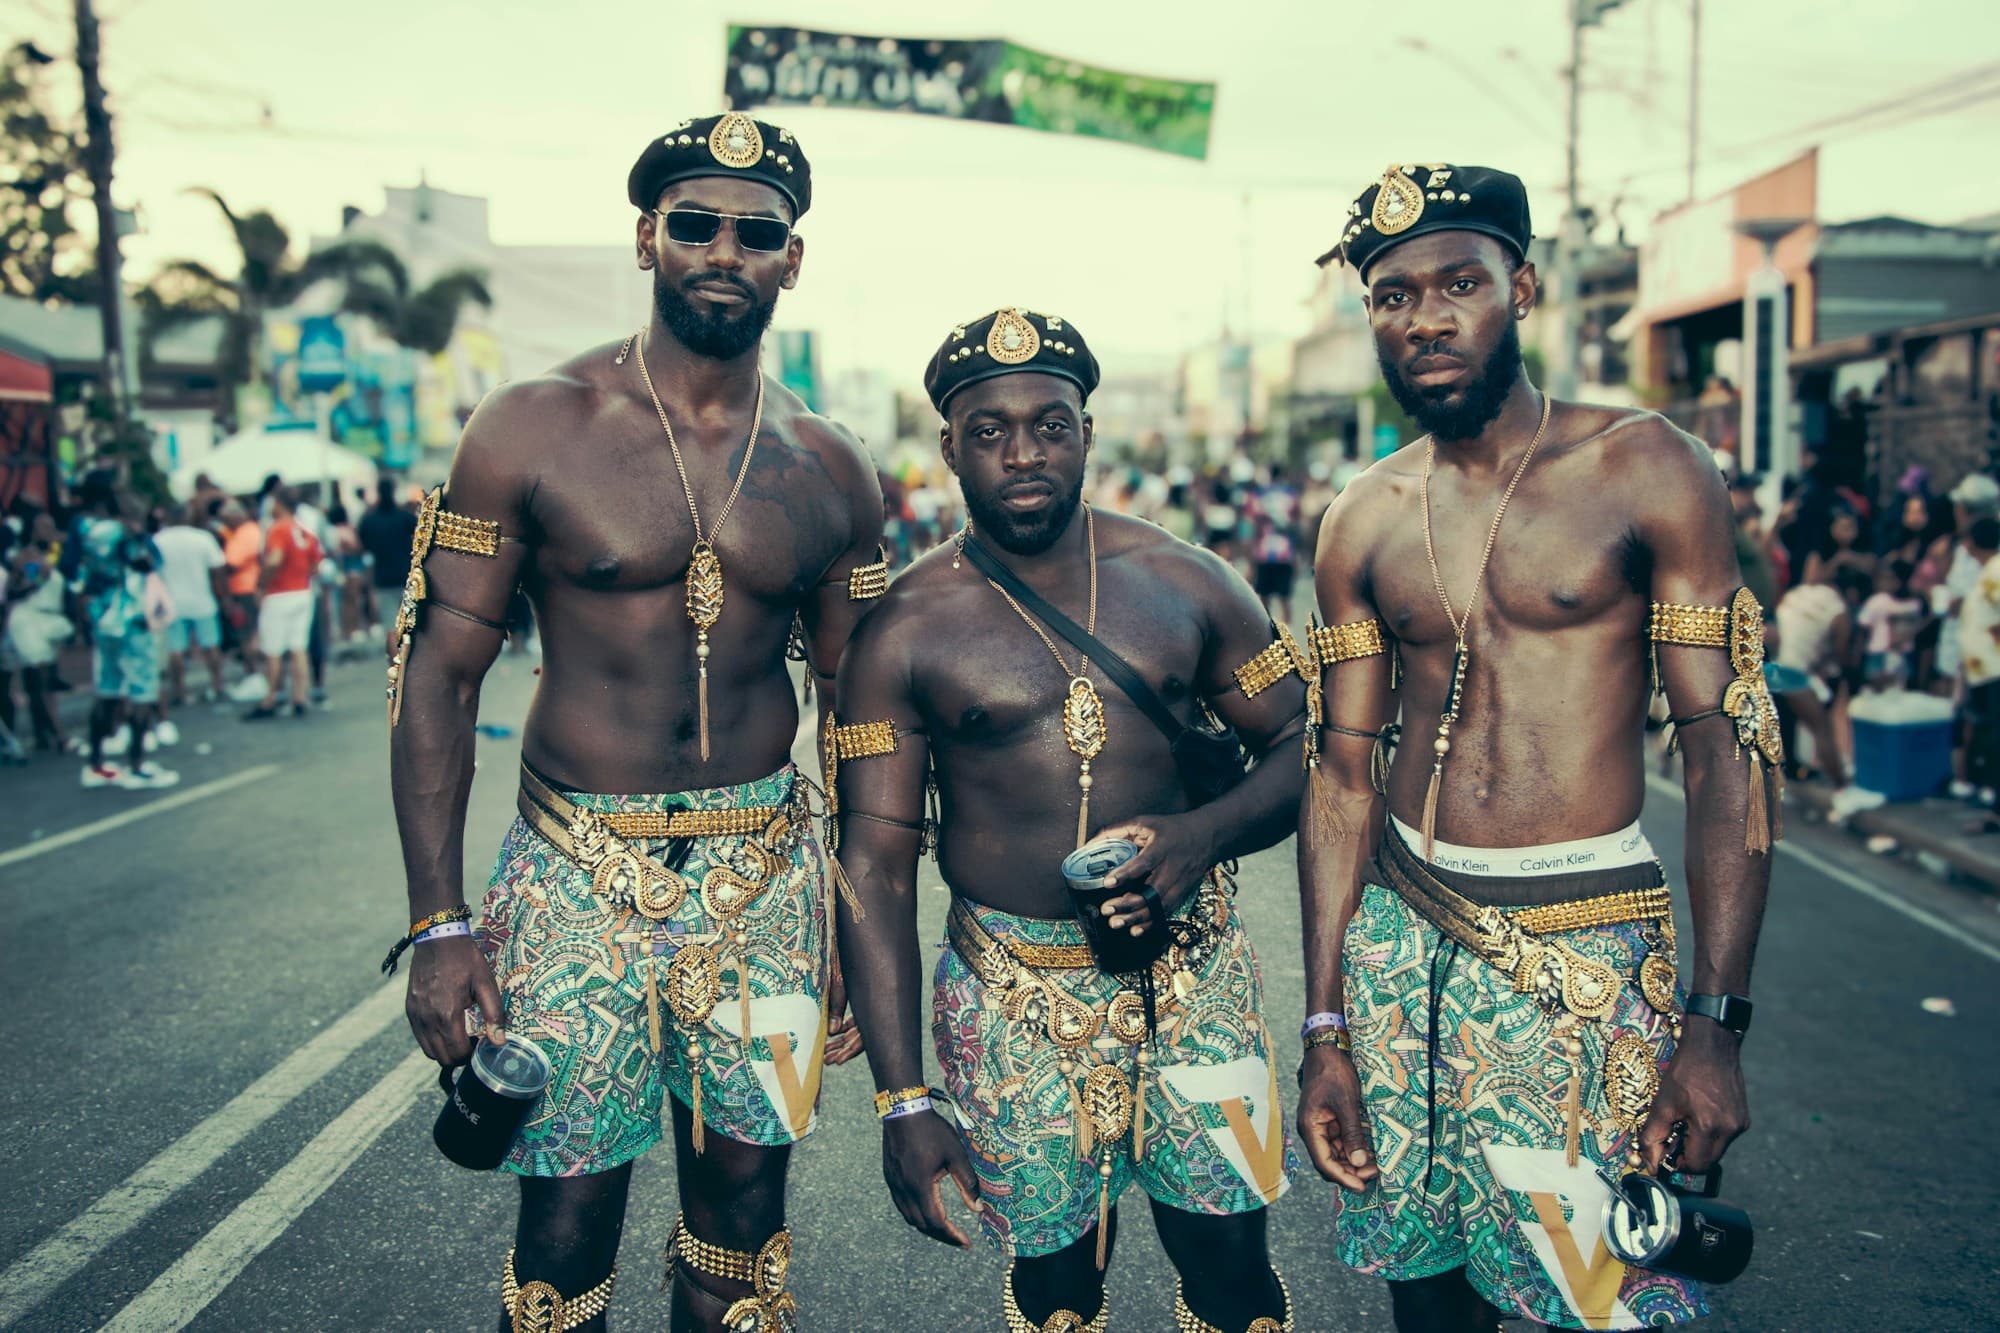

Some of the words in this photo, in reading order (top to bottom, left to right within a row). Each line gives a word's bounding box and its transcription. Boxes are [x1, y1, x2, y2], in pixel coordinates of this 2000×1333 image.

[1434, 855, 1459, 869] alvin
[1461, 859, 1489, 872] Klein
[1519, 856, 1563, 871] Calvin
[1566, 851, 1596, 866] Klein
